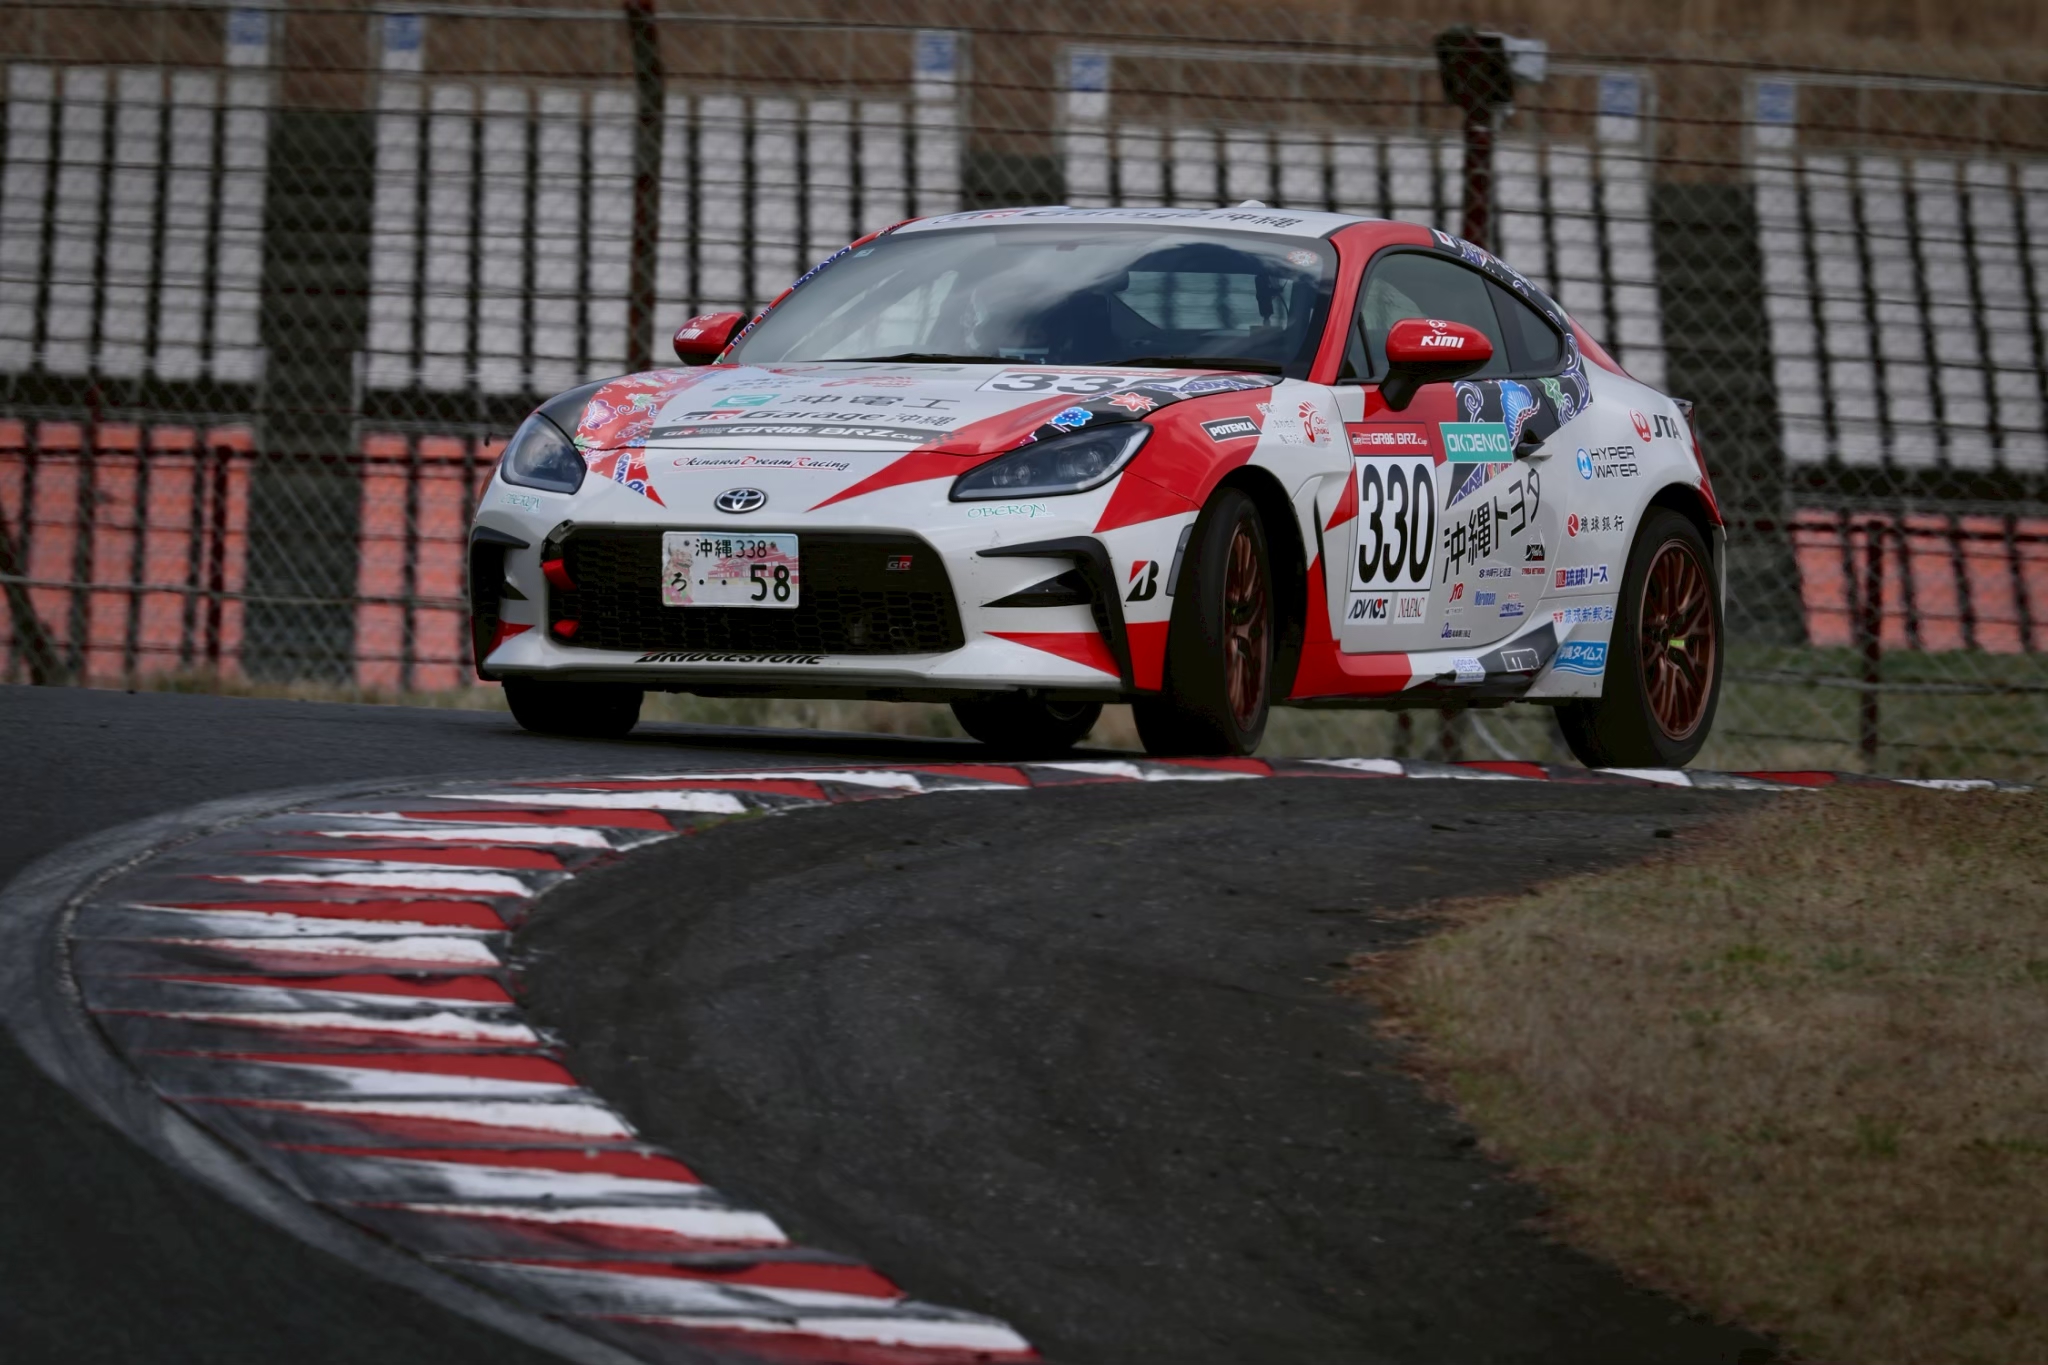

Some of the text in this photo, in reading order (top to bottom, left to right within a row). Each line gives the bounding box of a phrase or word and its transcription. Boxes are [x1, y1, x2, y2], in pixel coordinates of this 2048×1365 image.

[739, 410, 885, 422] Garage
[1208, 421, 1257, 437] POTENZA
[1653, 414, 1683, 440] JTA
[1589, 445, 1636, 461] HYPER
[673, 455, 851, 471] Okinawa Dream Racing
[1593, 463, 1639, 478] WATER
[967, 503, 1047, 518] OBERON
[1358, 463, 1434, 584] 330
[1442, 467, 1540, 585] 沖縄トヨタ
[1580, 514, 1625, 533] 琉球銀行
[695, 538, 767, 558] 沖縄 338
[1566, 565, 1609, 587] 琉球リース
[1398, 597, 1426, 618] NAPAC
